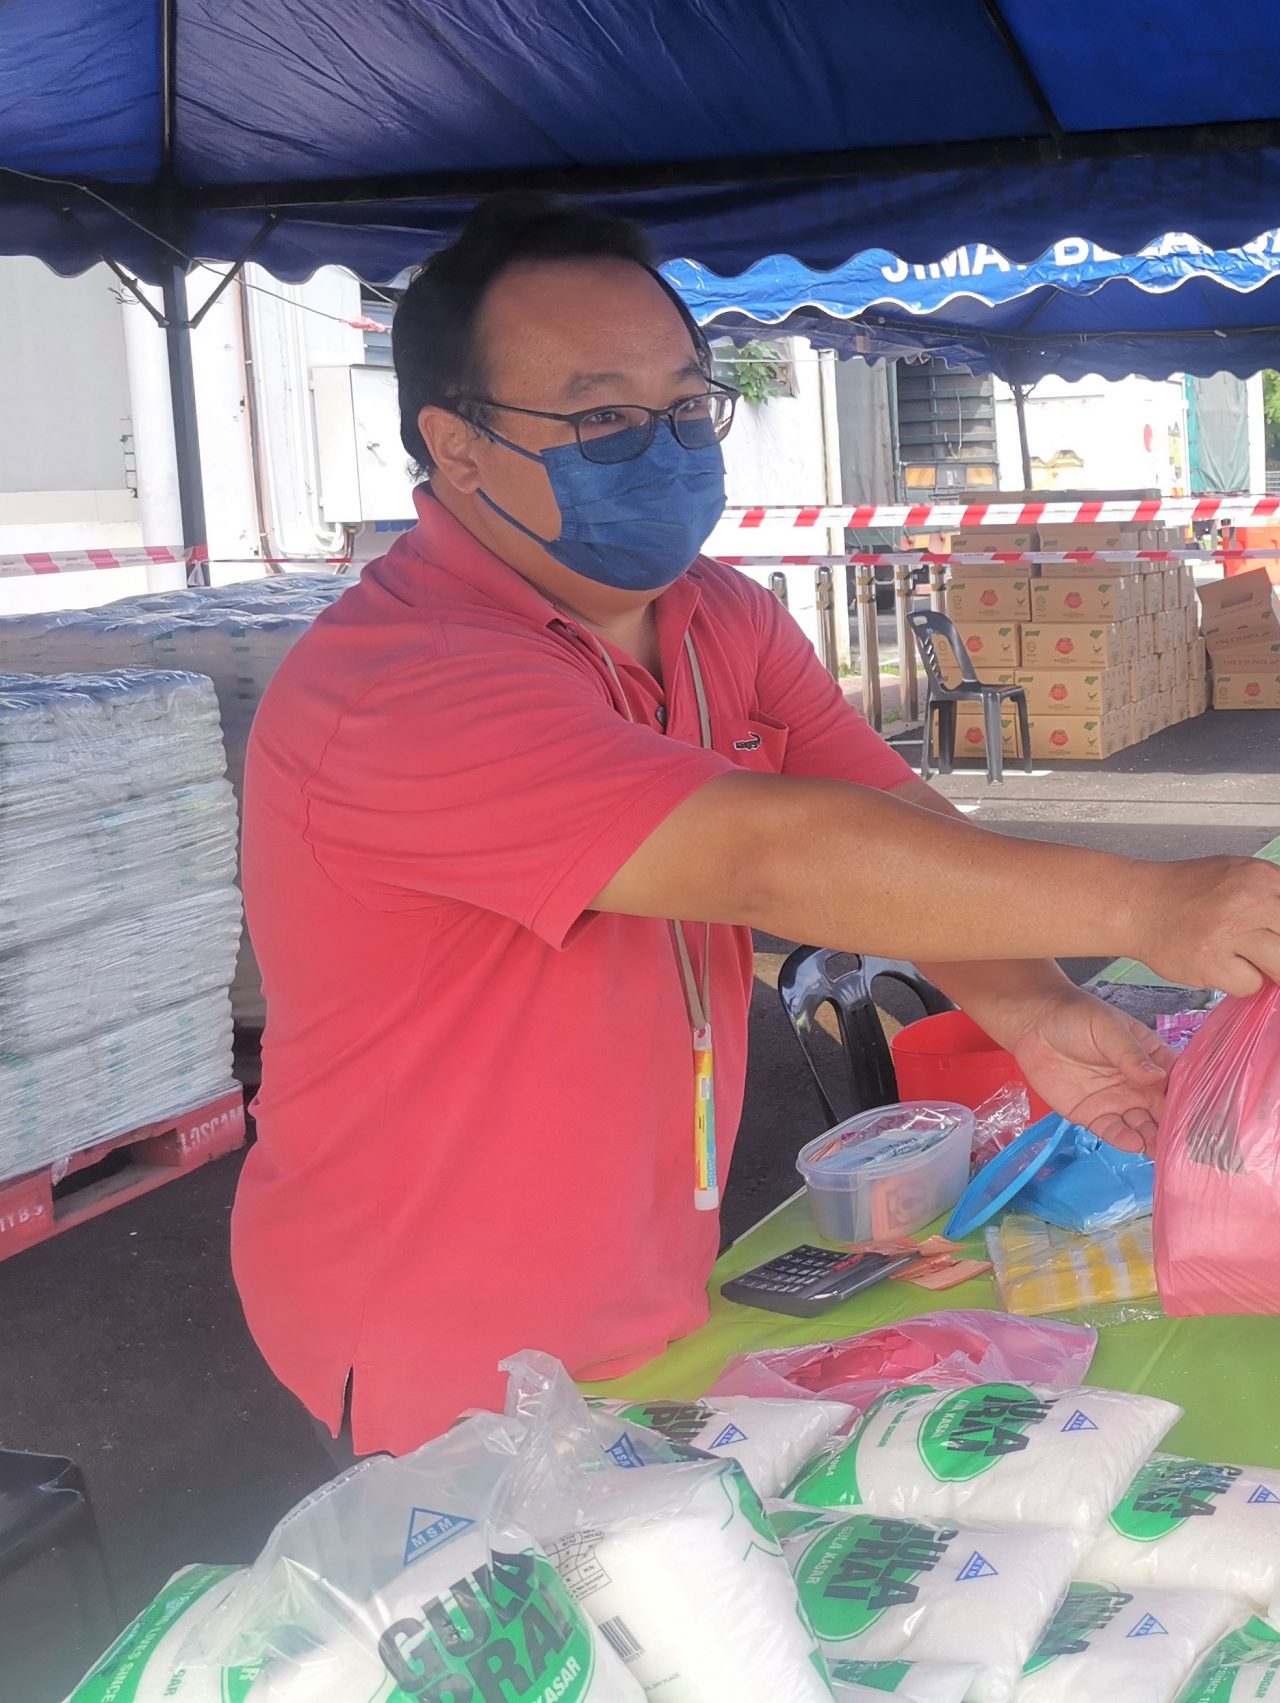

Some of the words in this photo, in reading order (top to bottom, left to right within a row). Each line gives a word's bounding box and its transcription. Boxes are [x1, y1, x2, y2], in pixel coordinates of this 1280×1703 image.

[411, 1517, 455, 1549] MSM
[828, 1526, 855, 1550] GULA
[805, 1551, 839, 1585] KASAR
[822, 1518, 915, 1600] PRAI
[378, 1549, 537, 1694] GULA
[127, 1626, 161, 1661] LIVES
[101, 1661, 135, 1703] SINCE
